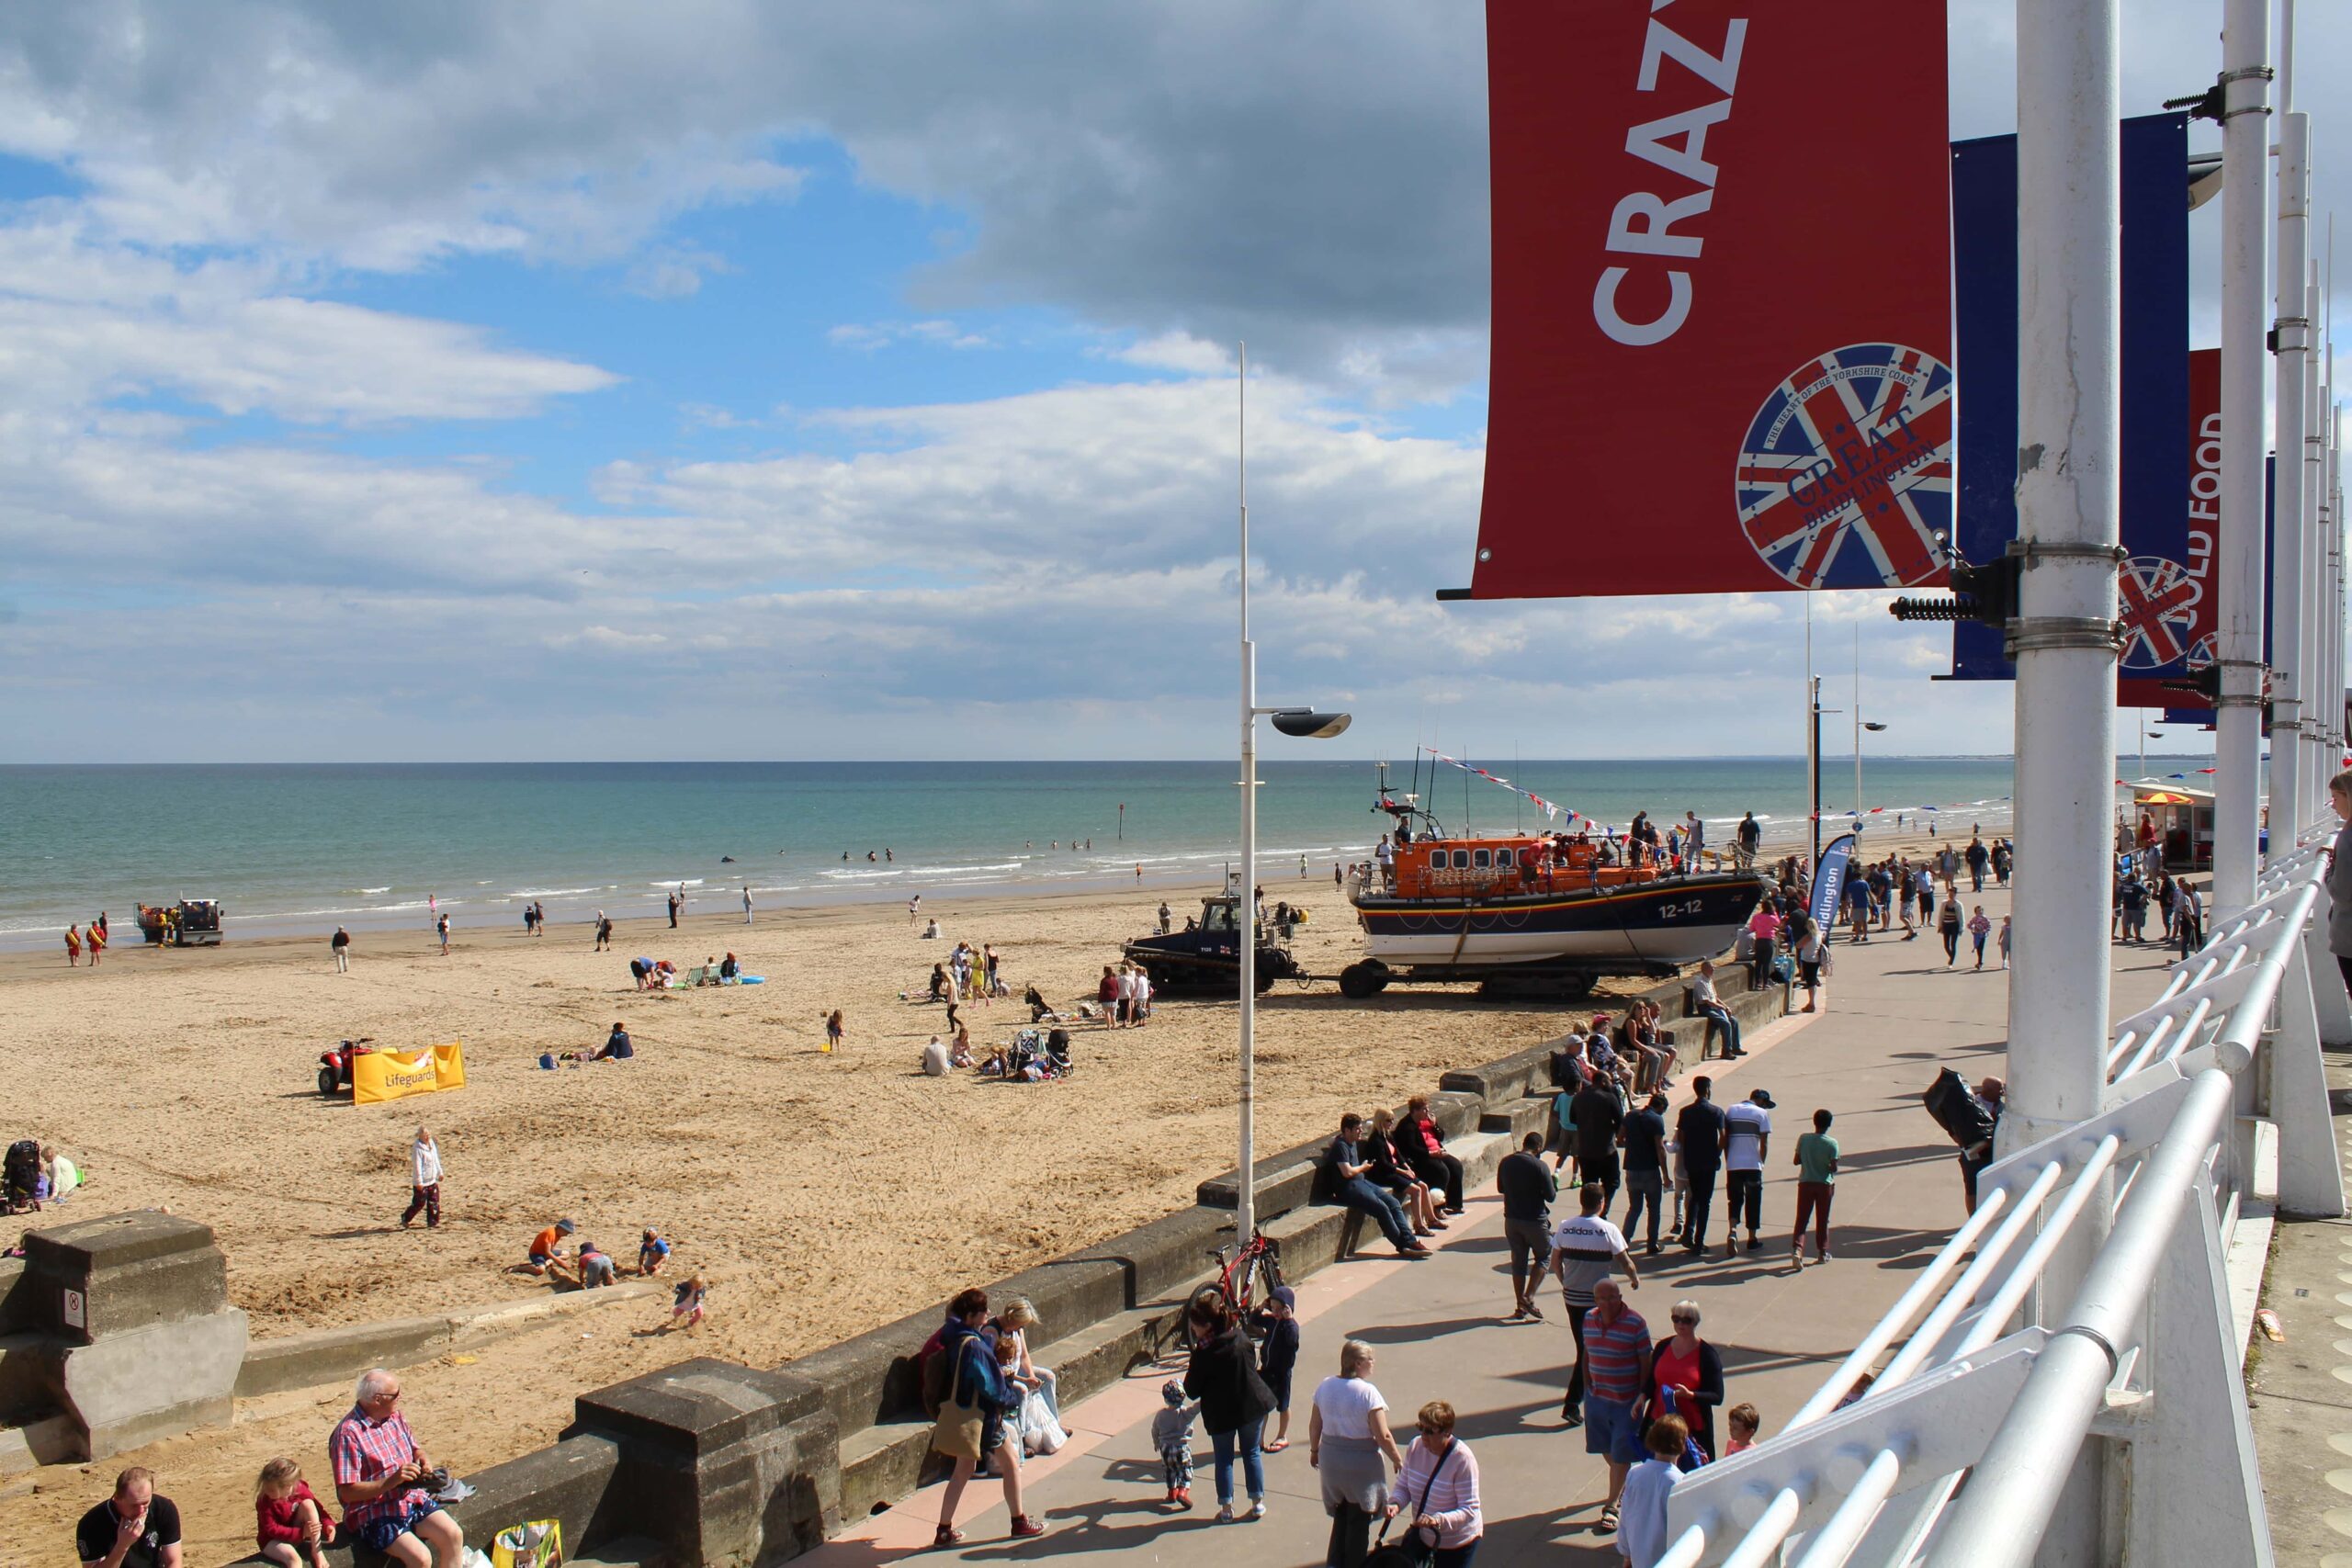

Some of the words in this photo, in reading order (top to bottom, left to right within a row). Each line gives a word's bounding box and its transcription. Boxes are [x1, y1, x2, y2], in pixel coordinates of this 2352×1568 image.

[1593, 0, 1749, 346] CRAZ
[1767, 425, 1781, 445] THE
[1777, 397, 1802, 425] HEART
[1801, 388, 1814, 400] OF
[1813, 376, 1832, 391] THE
[1832, 367, 1888, 382] YORKSHIRE
[1888, 369, 1918, 388] COAST
[1787, 405, 1919, 508] GREAT
[1804, 440, 1939, 531] BRIDLINGTON
[2188, 412, 2221, 521] FOOD
[1658, 899, 1702, 919] 12-12
[385, 1069, 435, 1089] Lifeguards
[1563, 1226, 1594, 1235] adidas
